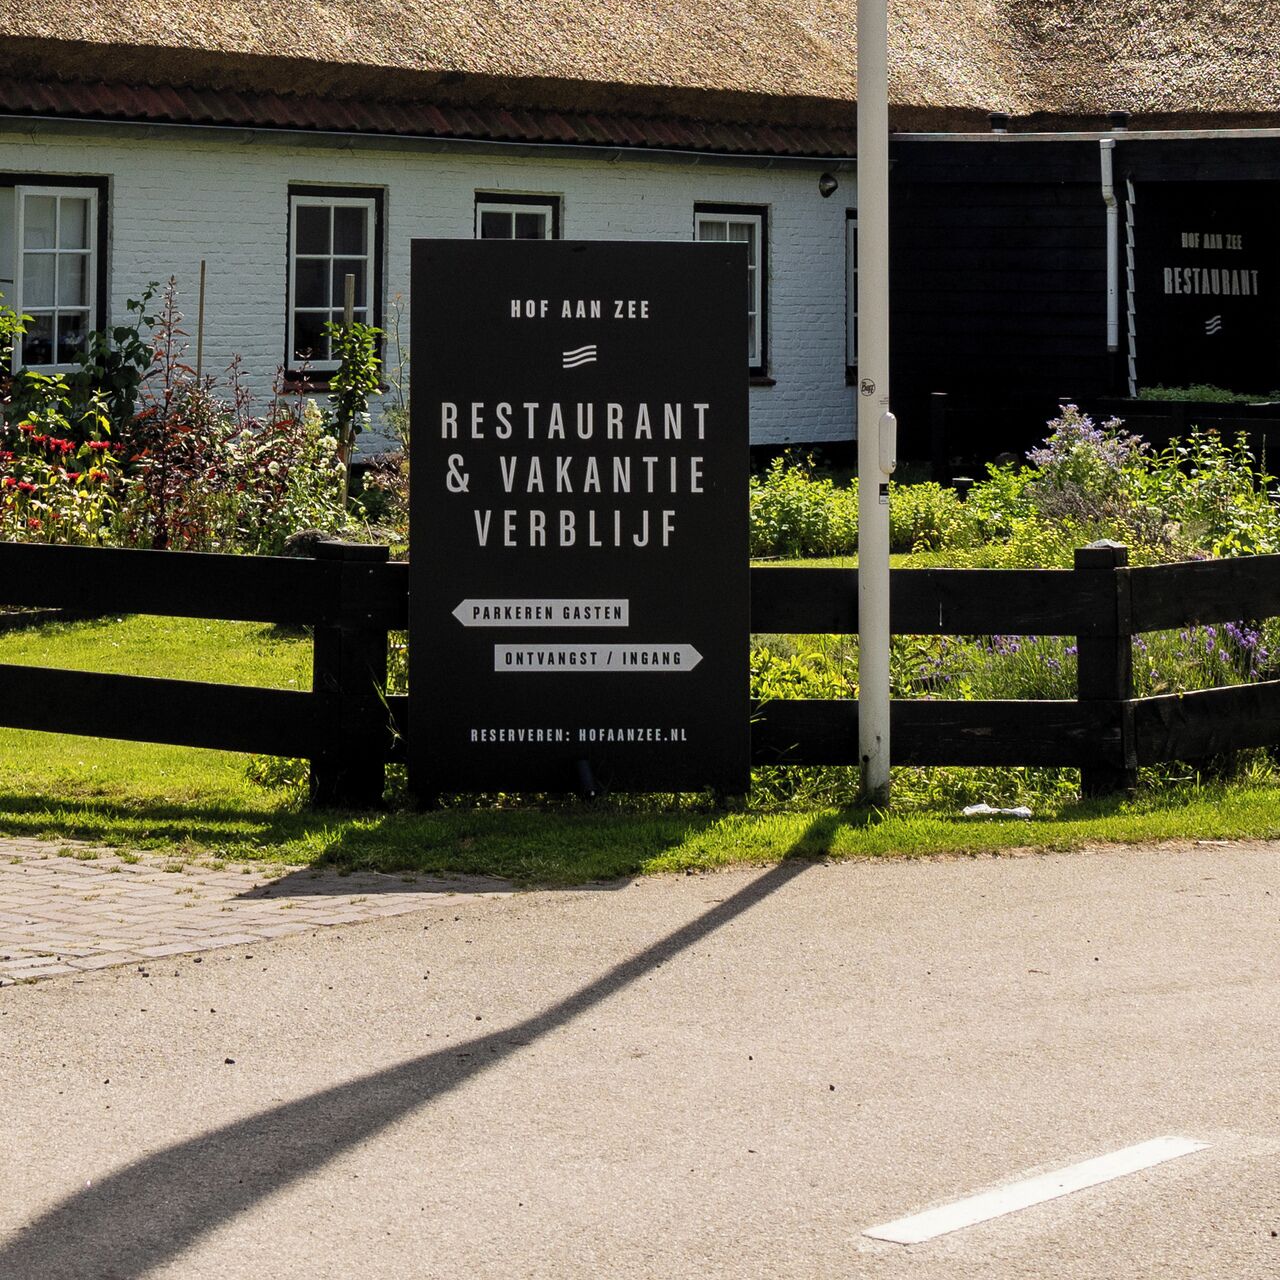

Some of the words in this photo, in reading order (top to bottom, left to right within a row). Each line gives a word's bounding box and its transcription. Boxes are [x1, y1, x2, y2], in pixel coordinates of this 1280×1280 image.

[1182, 233, 1199, 248] HOF
[1204, 234, 1222, 249] AAN
[1226, 234, 1242, 249] ZEE
[1164, 267, 1258, 295] RESTAURANT
[511, 300, 548, 318] HOF
[562, 300, 600, 318] AAN
[614, 301, 648, 318] ZEE
[442, 402, 709, 439] RESTAURANT
[446, 454, 469, 492] &
[500, 456, 703, 493] VAKANTIE
[474, 510, 675, 547] VERBLIJF
[473, 607, 552, 619] PARKEREN
[563, 607, 621, 619] GASTEN
[506, 652, 597, 665] ONTVANGST
[607, 651, 612, 664] /
[623, 652, 680, 665] INGANG
[471, 729, 569, 741] RESERVEREN:
[580, 729, 686, 741] HOFAANZEE.NL
